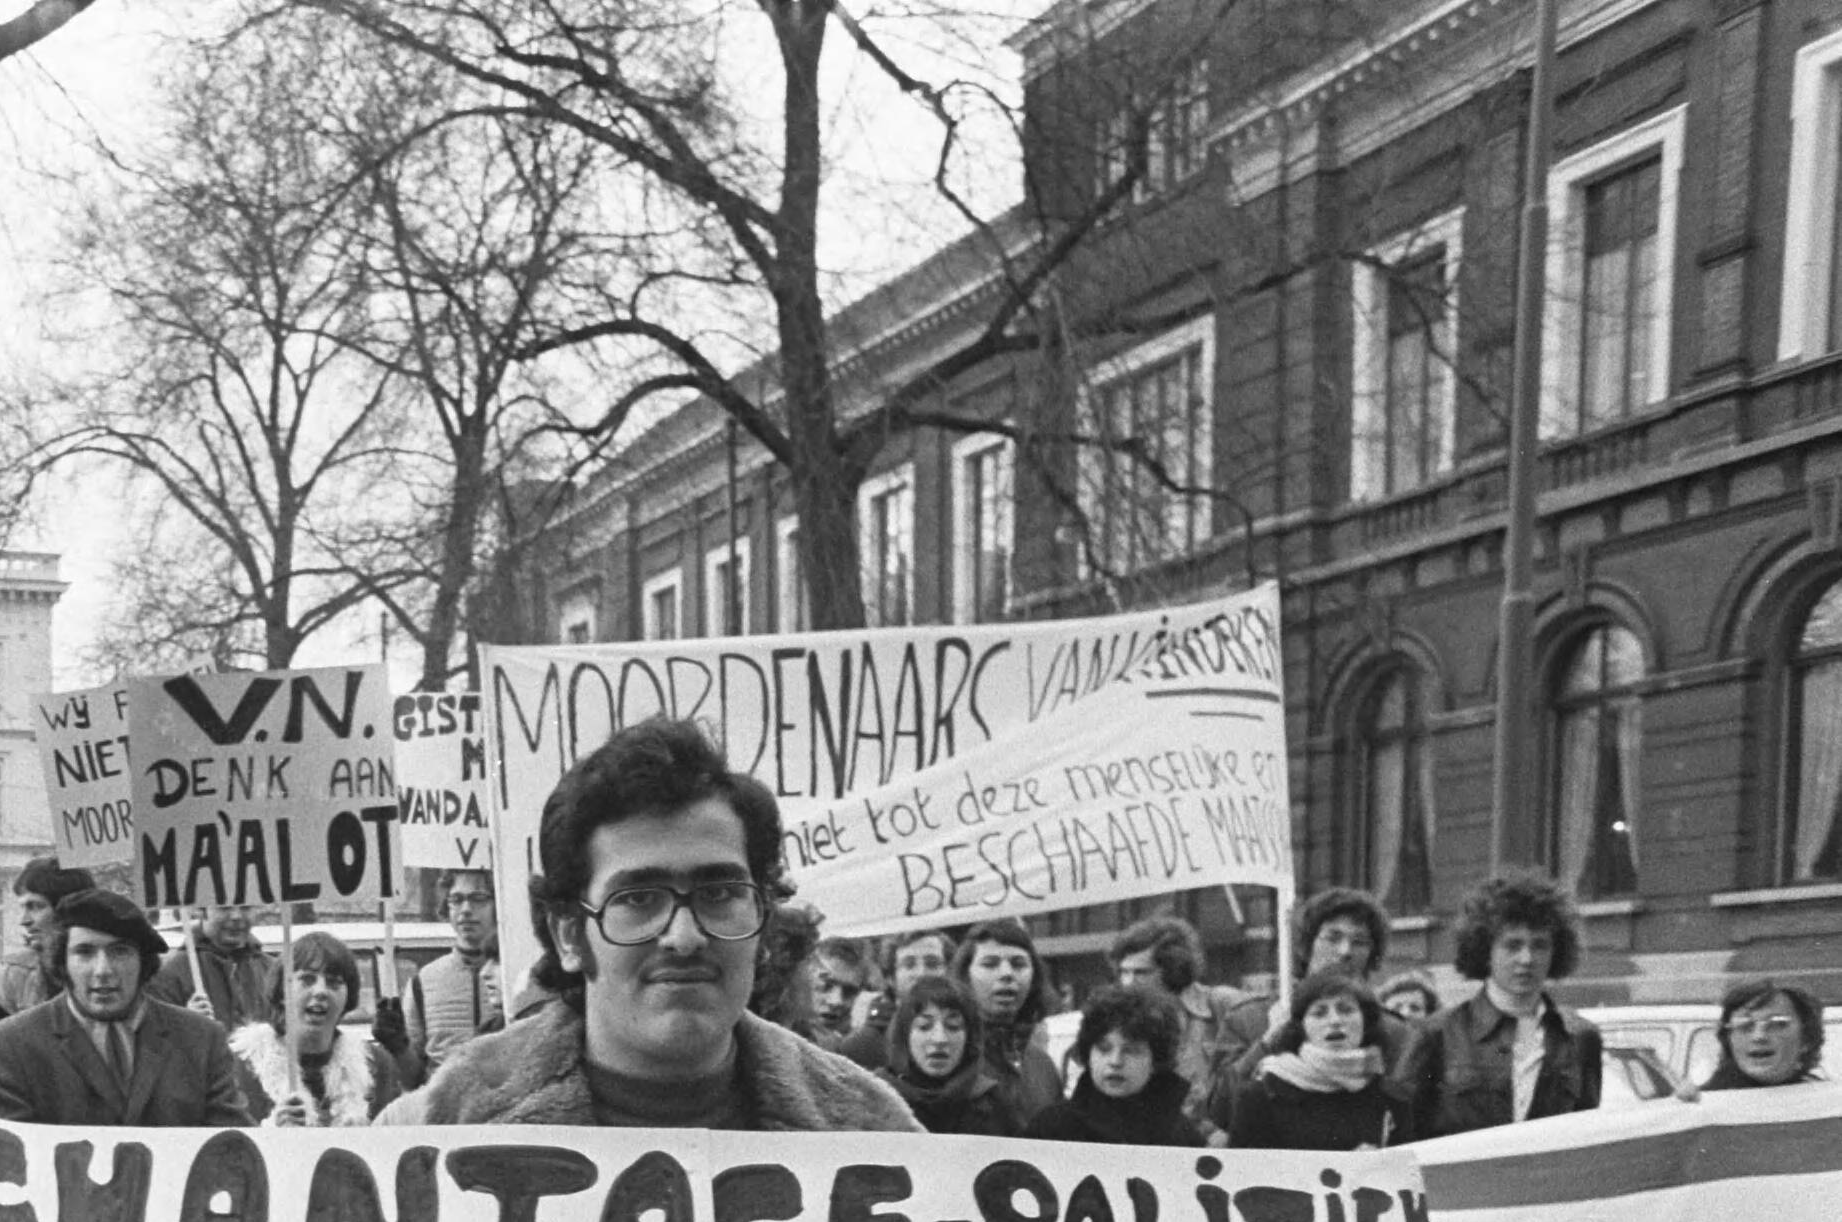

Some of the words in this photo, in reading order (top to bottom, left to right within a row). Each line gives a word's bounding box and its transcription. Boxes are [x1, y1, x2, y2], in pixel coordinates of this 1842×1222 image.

[163, 671, 374, 746] V.N.
[145, 755, 291, 808] DENK
[330, 756, 395, 798] AAN
[398, 787, 489, 828] VANDA
[863, 798, 941, 844] tot
[957, 770, 1048, 826] deze
[897, 797, 1203, 917] BESCHAAFDE
